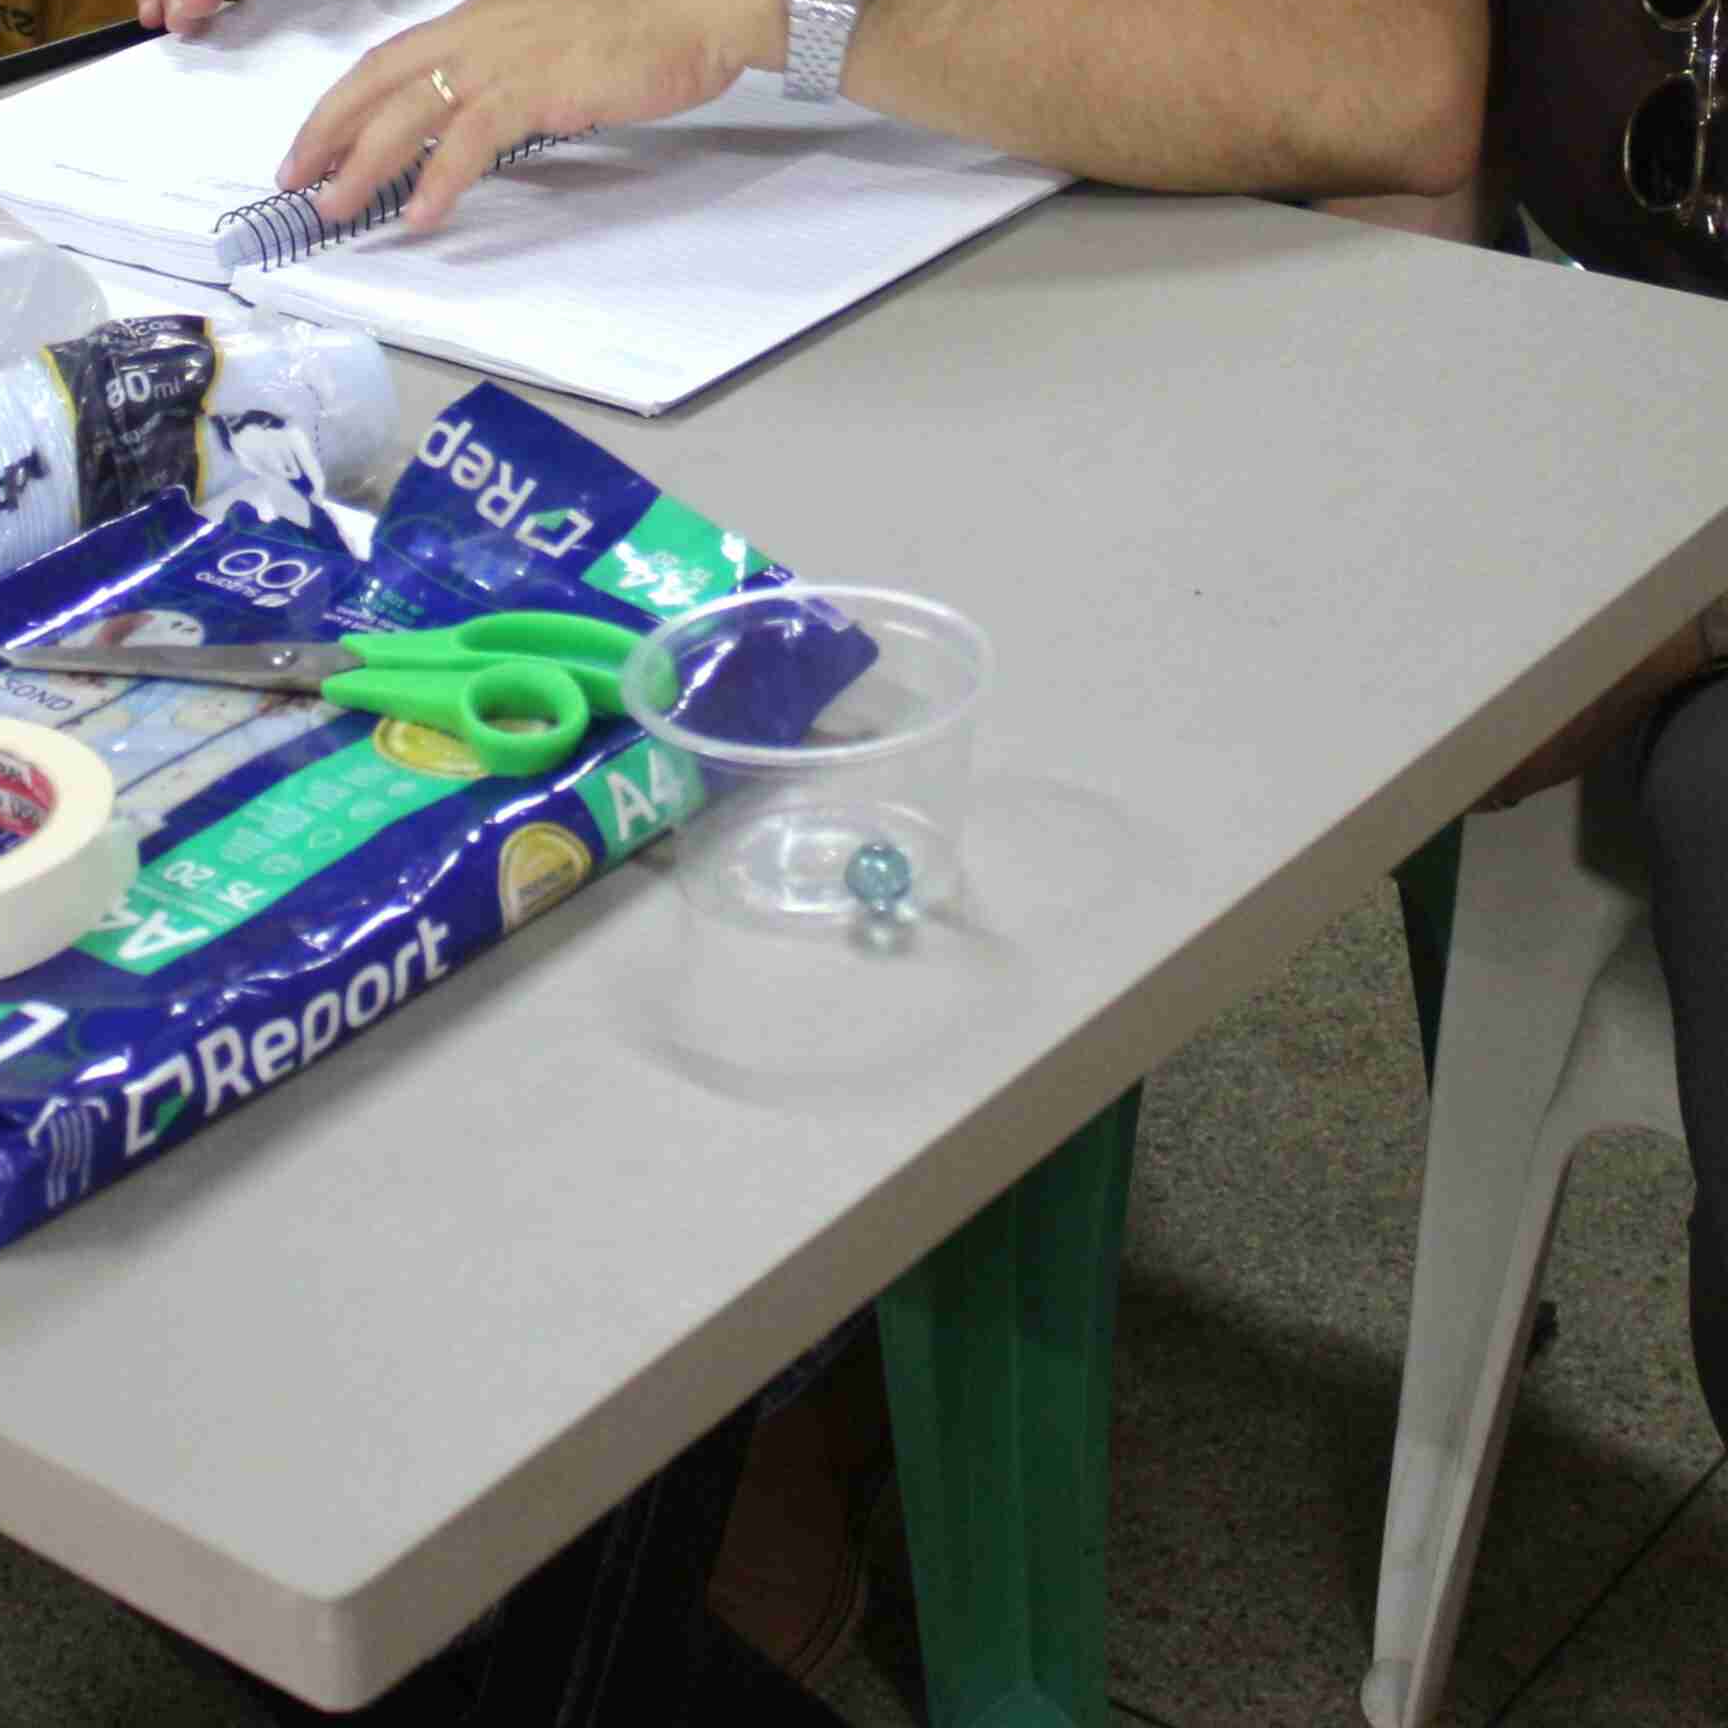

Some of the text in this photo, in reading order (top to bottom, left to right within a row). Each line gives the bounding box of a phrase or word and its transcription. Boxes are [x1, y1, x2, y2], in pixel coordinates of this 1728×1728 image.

[421, 417, 538, 529] Rep
[608, 760, 687, 842] A4
[195, 915, 450, 1116] Report
